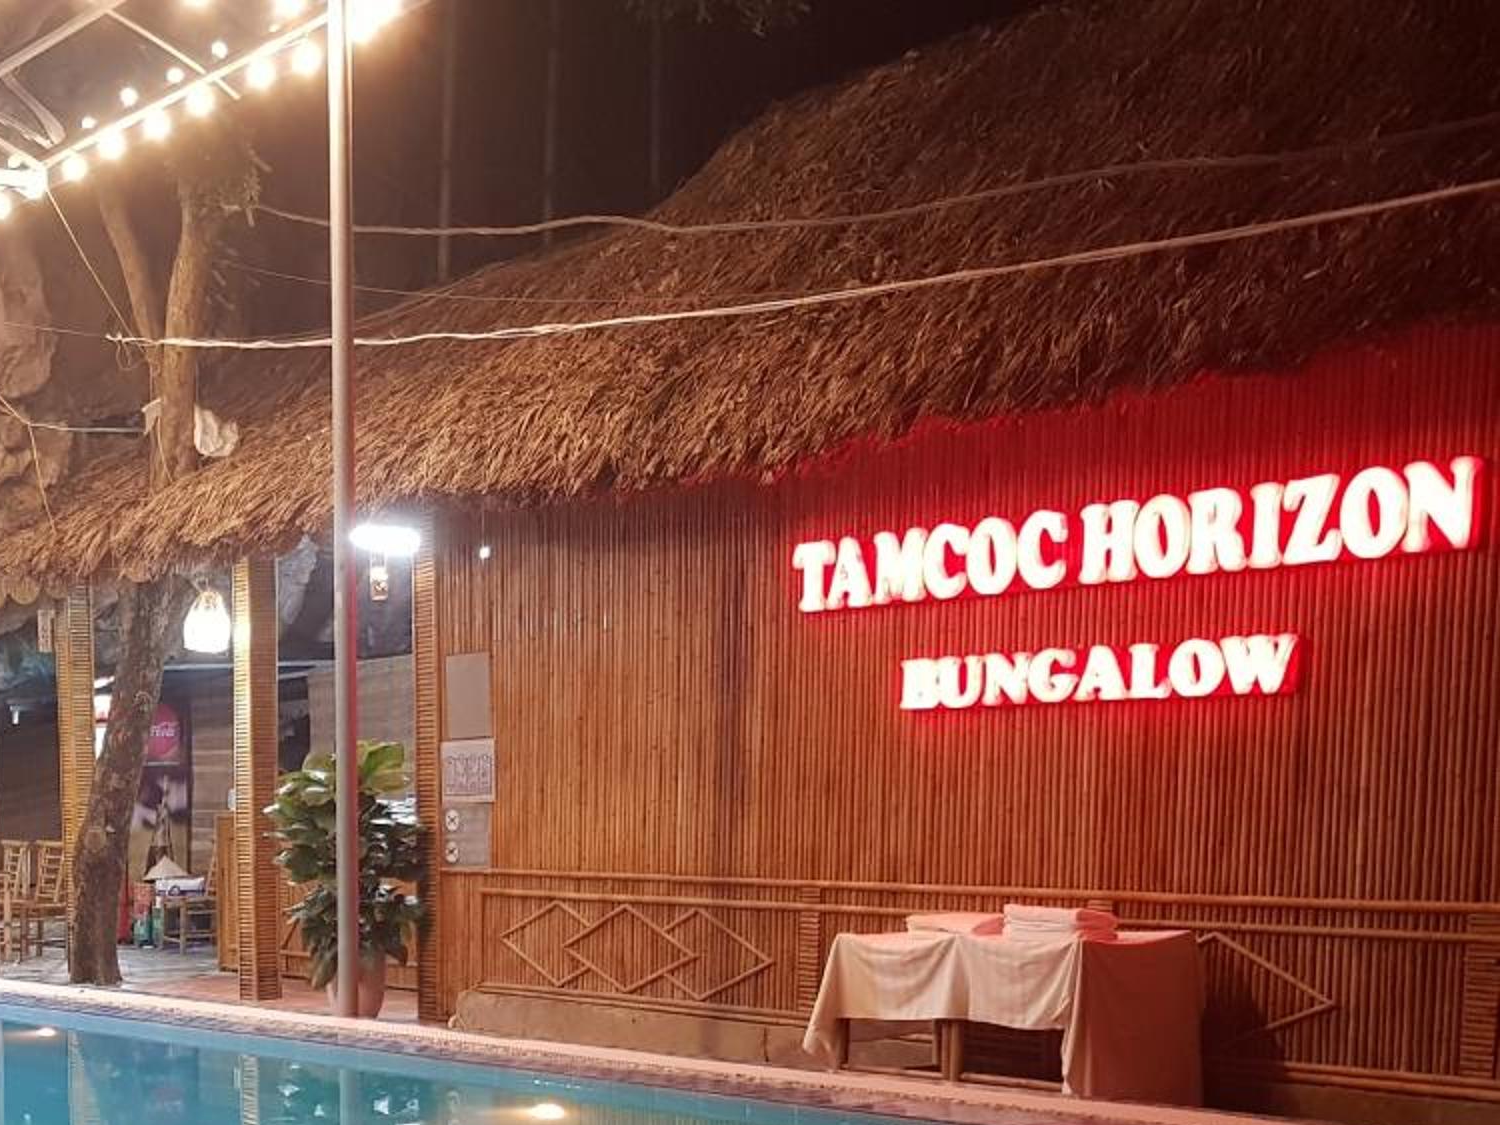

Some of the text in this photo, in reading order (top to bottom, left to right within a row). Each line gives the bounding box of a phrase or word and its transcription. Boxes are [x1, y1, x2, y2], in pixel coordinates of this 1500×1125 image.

[791, 456, 1482, 613] TAMCOC HORIZON
[898, 632, 1299, 711] BUNGALOW
